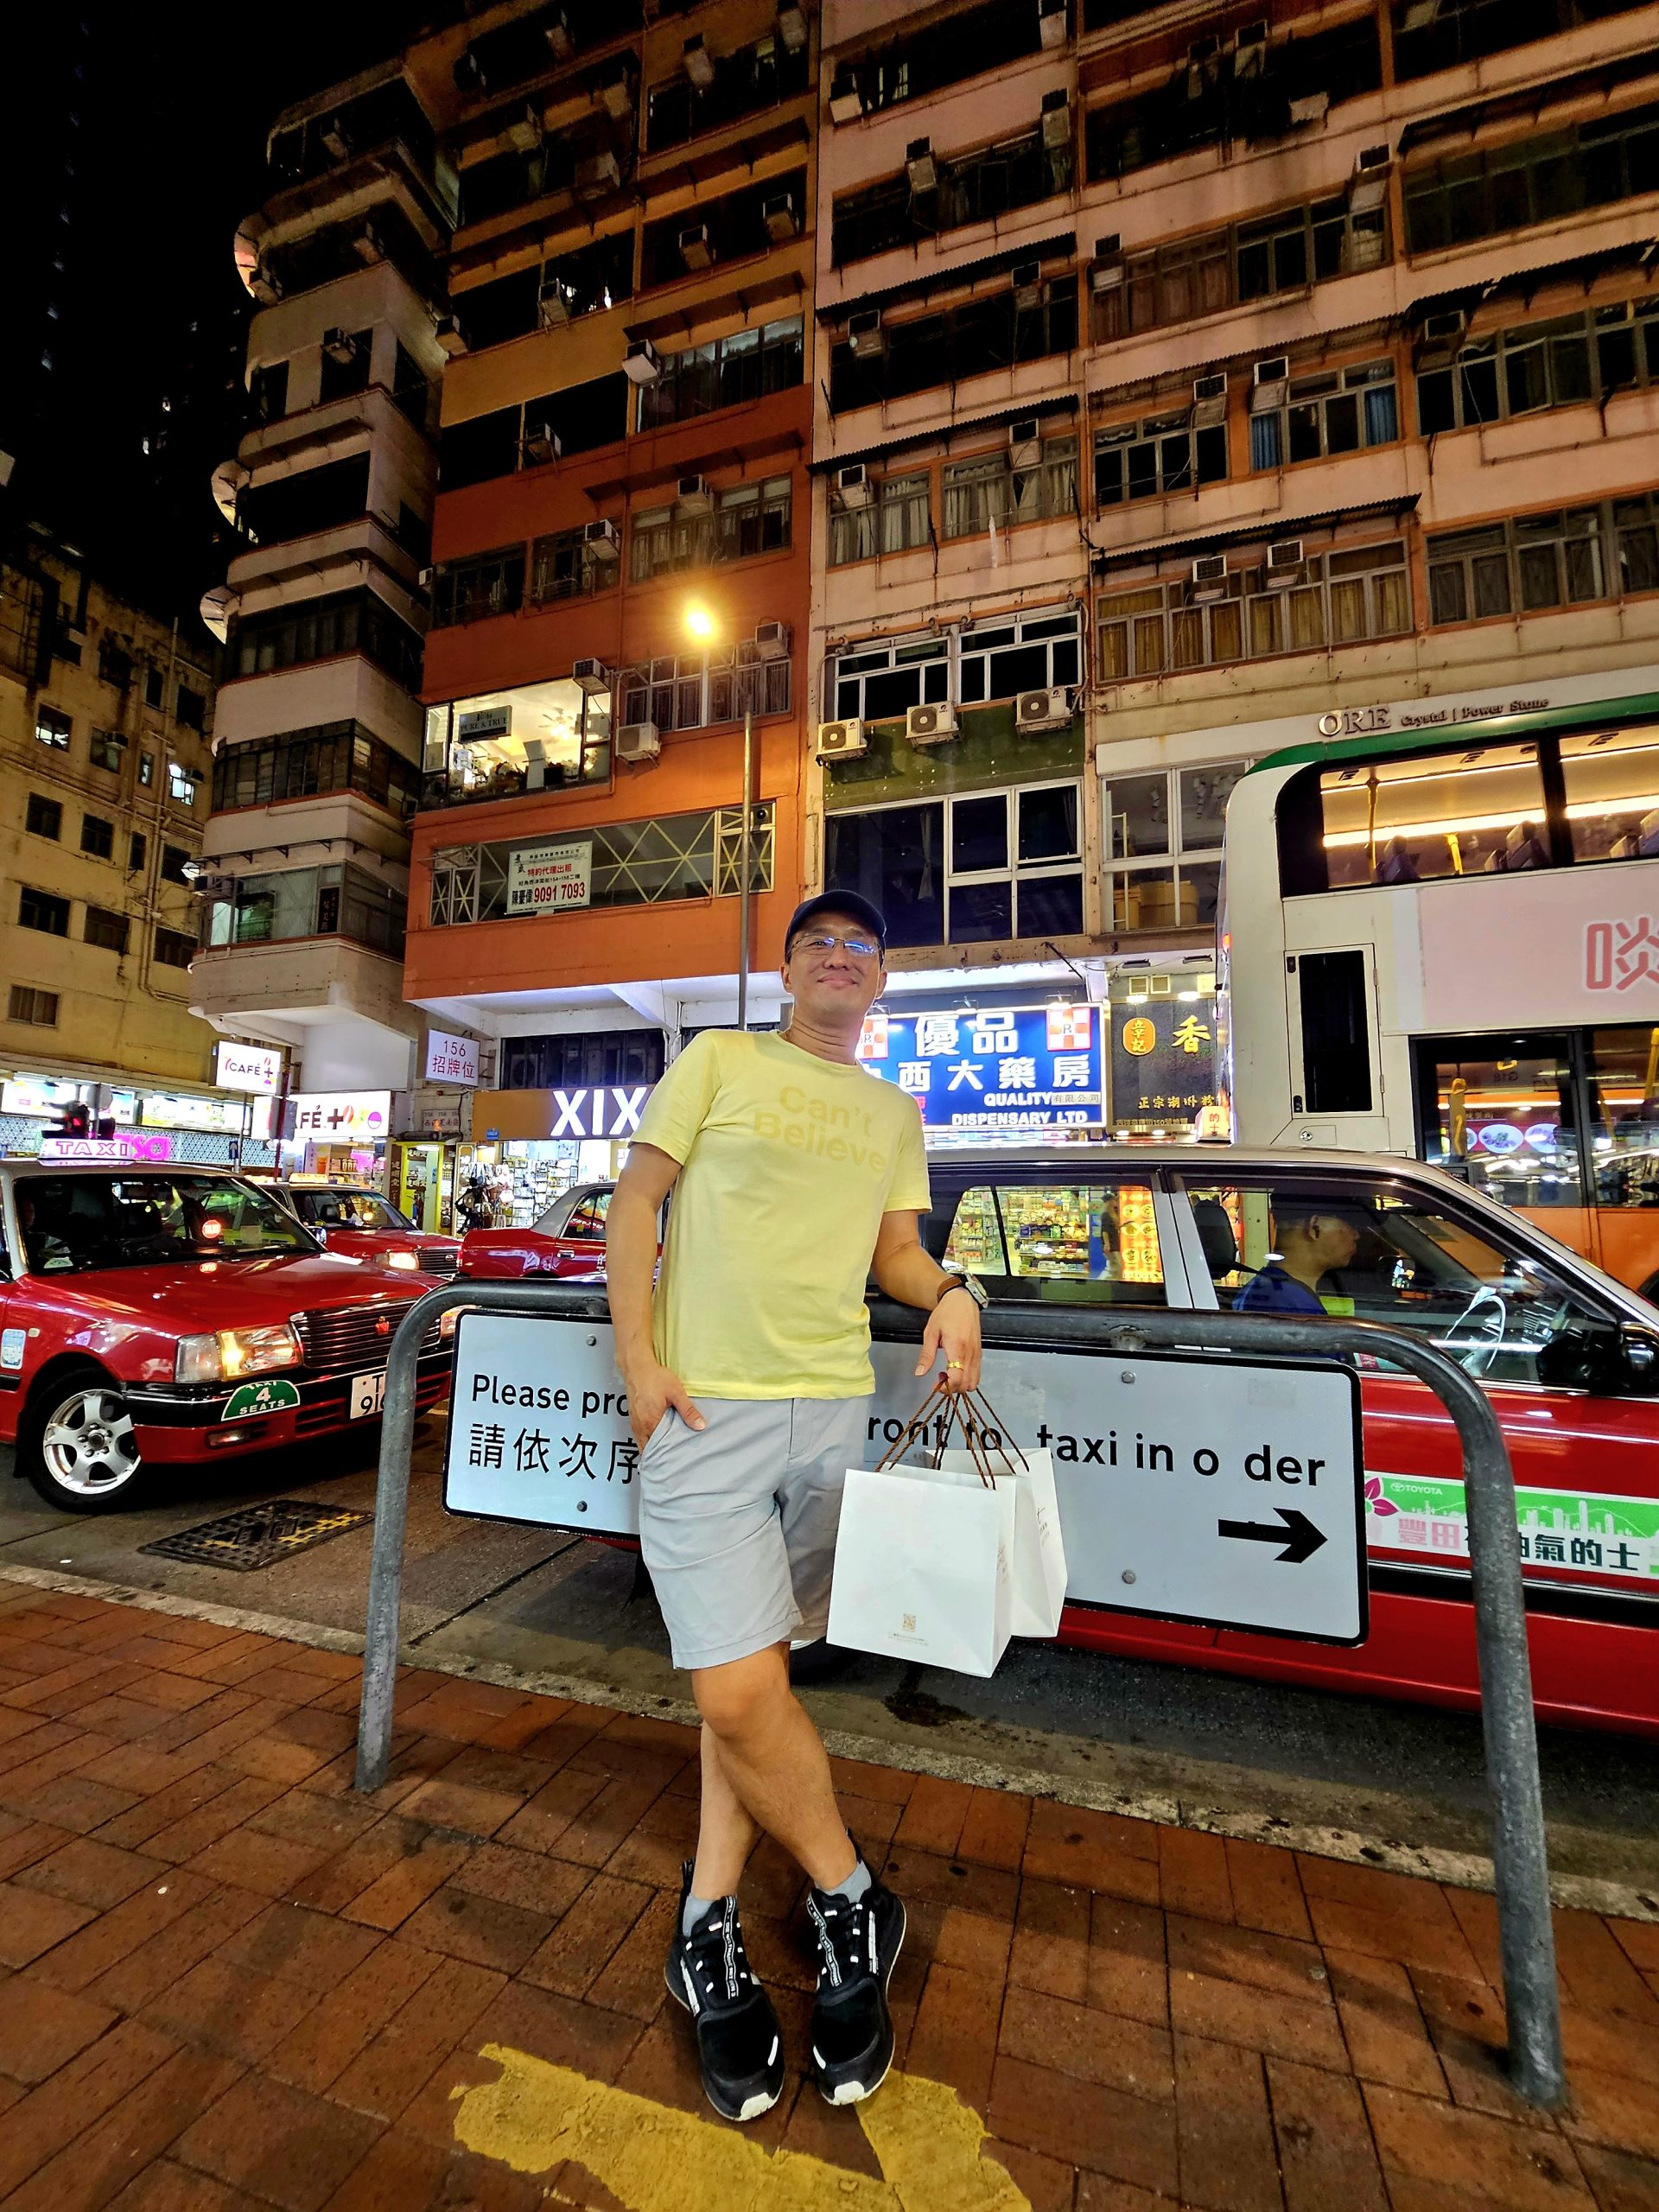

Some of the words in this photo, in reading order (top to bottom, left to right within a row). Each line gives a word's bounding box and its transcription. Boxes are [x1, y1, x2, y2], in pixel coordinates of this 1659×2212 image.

[1319, 707, 1391, 737] ORE
[1401, 709, 1447, 728] Crystal
[1462, 704, 1503, 719] Power
[1510, 698, 1549, 712] Stone
[534, 885, 557, 903] 9091
[561, 881, 585, 899] 7093
[915, 1011, 1019, 1058] 優品
[1171, 1014, 1211, 1054] 香
[443, 1039, 467, 1057] 156
[432, 1054, 475, 1079] 招牌位
[983, 1091, 1053, 1108] QUALITY
[1053, 1093, 1100, 1104] 有限公司
[550, 1086, 648, 1136] XIX
[779, 1085, 873, 1137] Can't
[951, 1110, 1052, 1127] DISPENSARY
[1056, 1109, 1089, 1125] LTD
[54, 1141, 129, 1157] TAXI
[753, 1111, 887, 1173] Believe
[255, 1387, 272, 1402] 4
[238, 1399, 286, 1415] SEATS
[472, 1373, 570, 1411] Please
[867, 1414, 949, 1449] ront
[1036, 1423, 1118, 1466] taxi
[1135, 1432, 1174, 1472] in
[468, 1422, 640, 1484] 請依次序
[1404, 1484, 1444, 1497] TOYOTA
